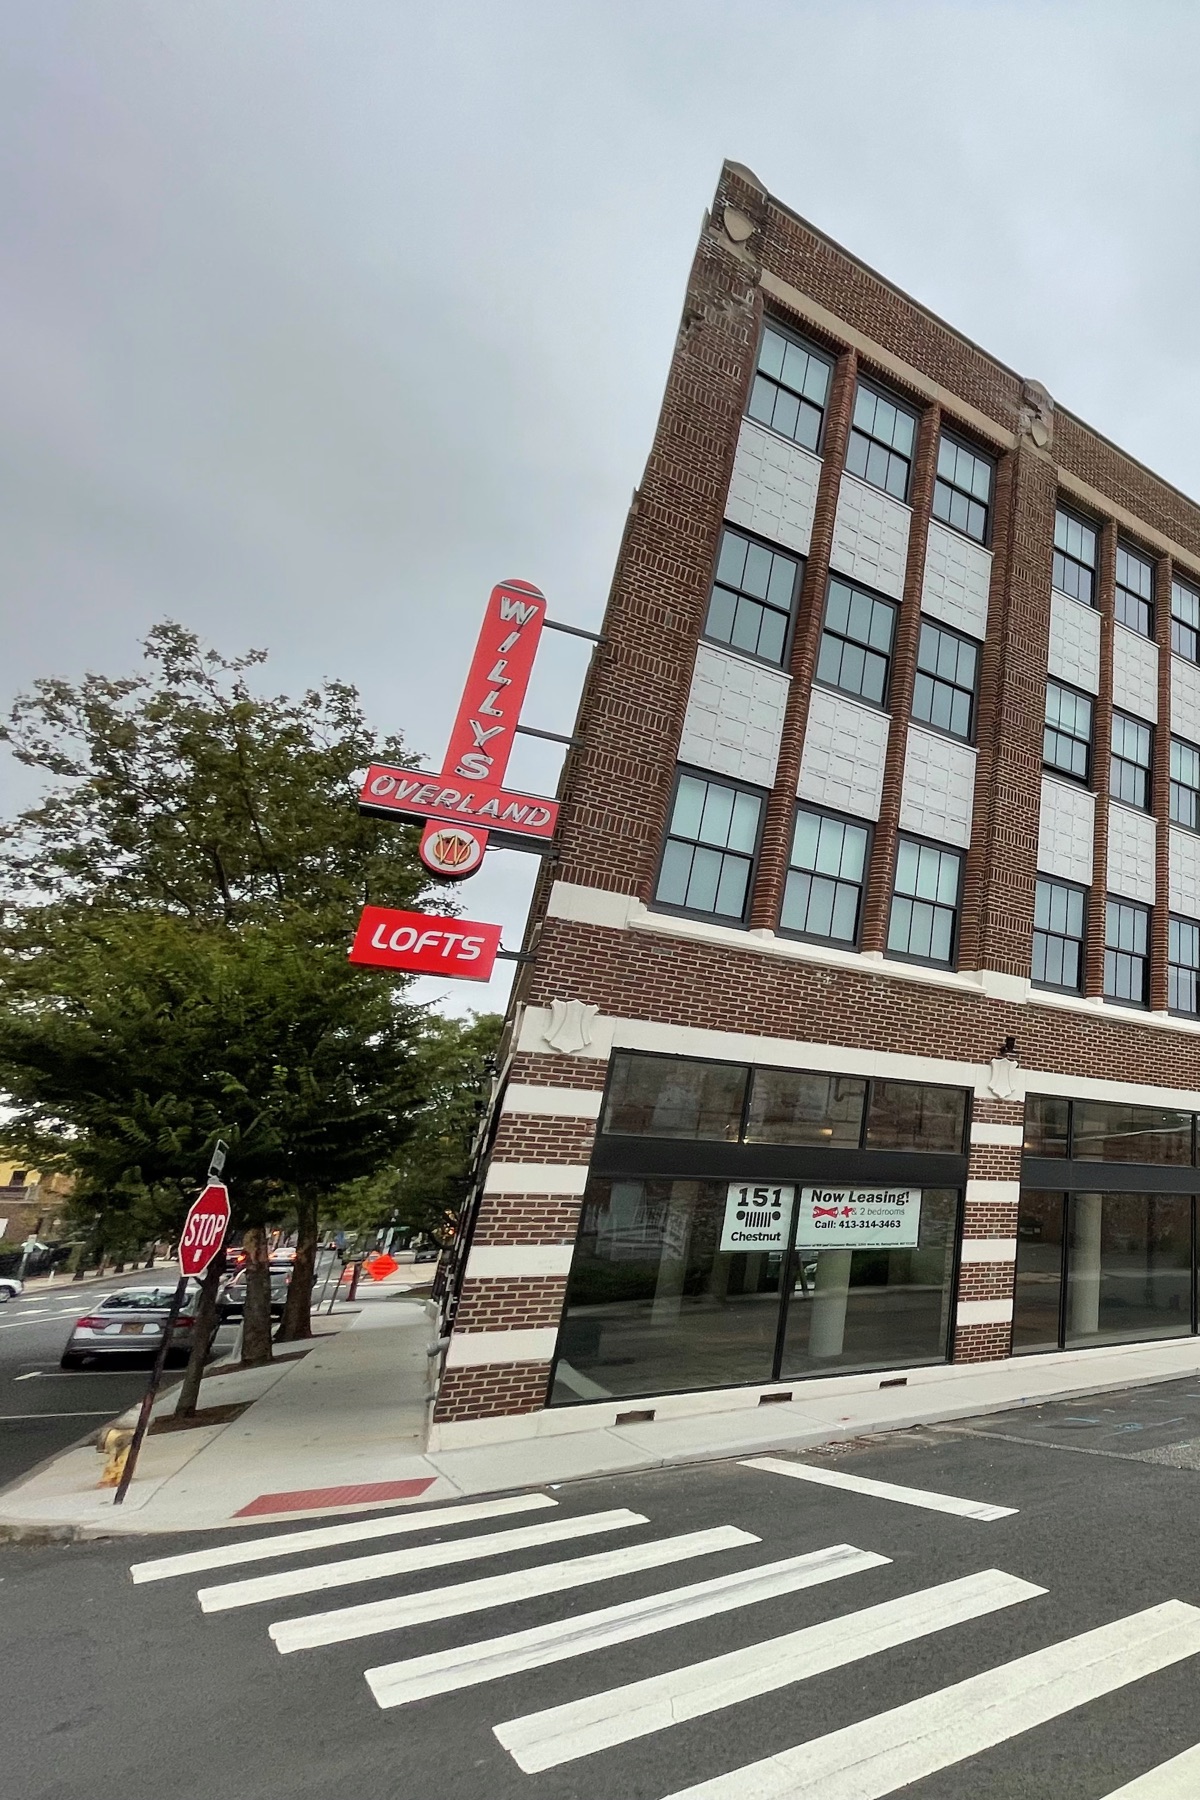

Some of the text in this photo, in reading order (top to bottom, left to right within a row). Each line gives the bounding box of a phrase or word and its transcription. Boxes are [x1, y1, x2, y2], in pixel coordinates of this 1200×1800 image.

[454, 596, 539, 780] WILLYS
[370, 775, 551, 827] OVERLAND
[371, 924, 485, 960] LOFTS
[737, 1187, 782, 1207] 151
[811, 1189, 910, 1206] Now Leasing!
[860, 1207, 865, 1216] 2
[867, 1207, 905, 1216] bedrooms
[184, 1213, 226, 1247] STOP
[815, 1220, 901, 1229] Call: 413-314-3463
[730, 1231, 781, 1242] Chestnut
